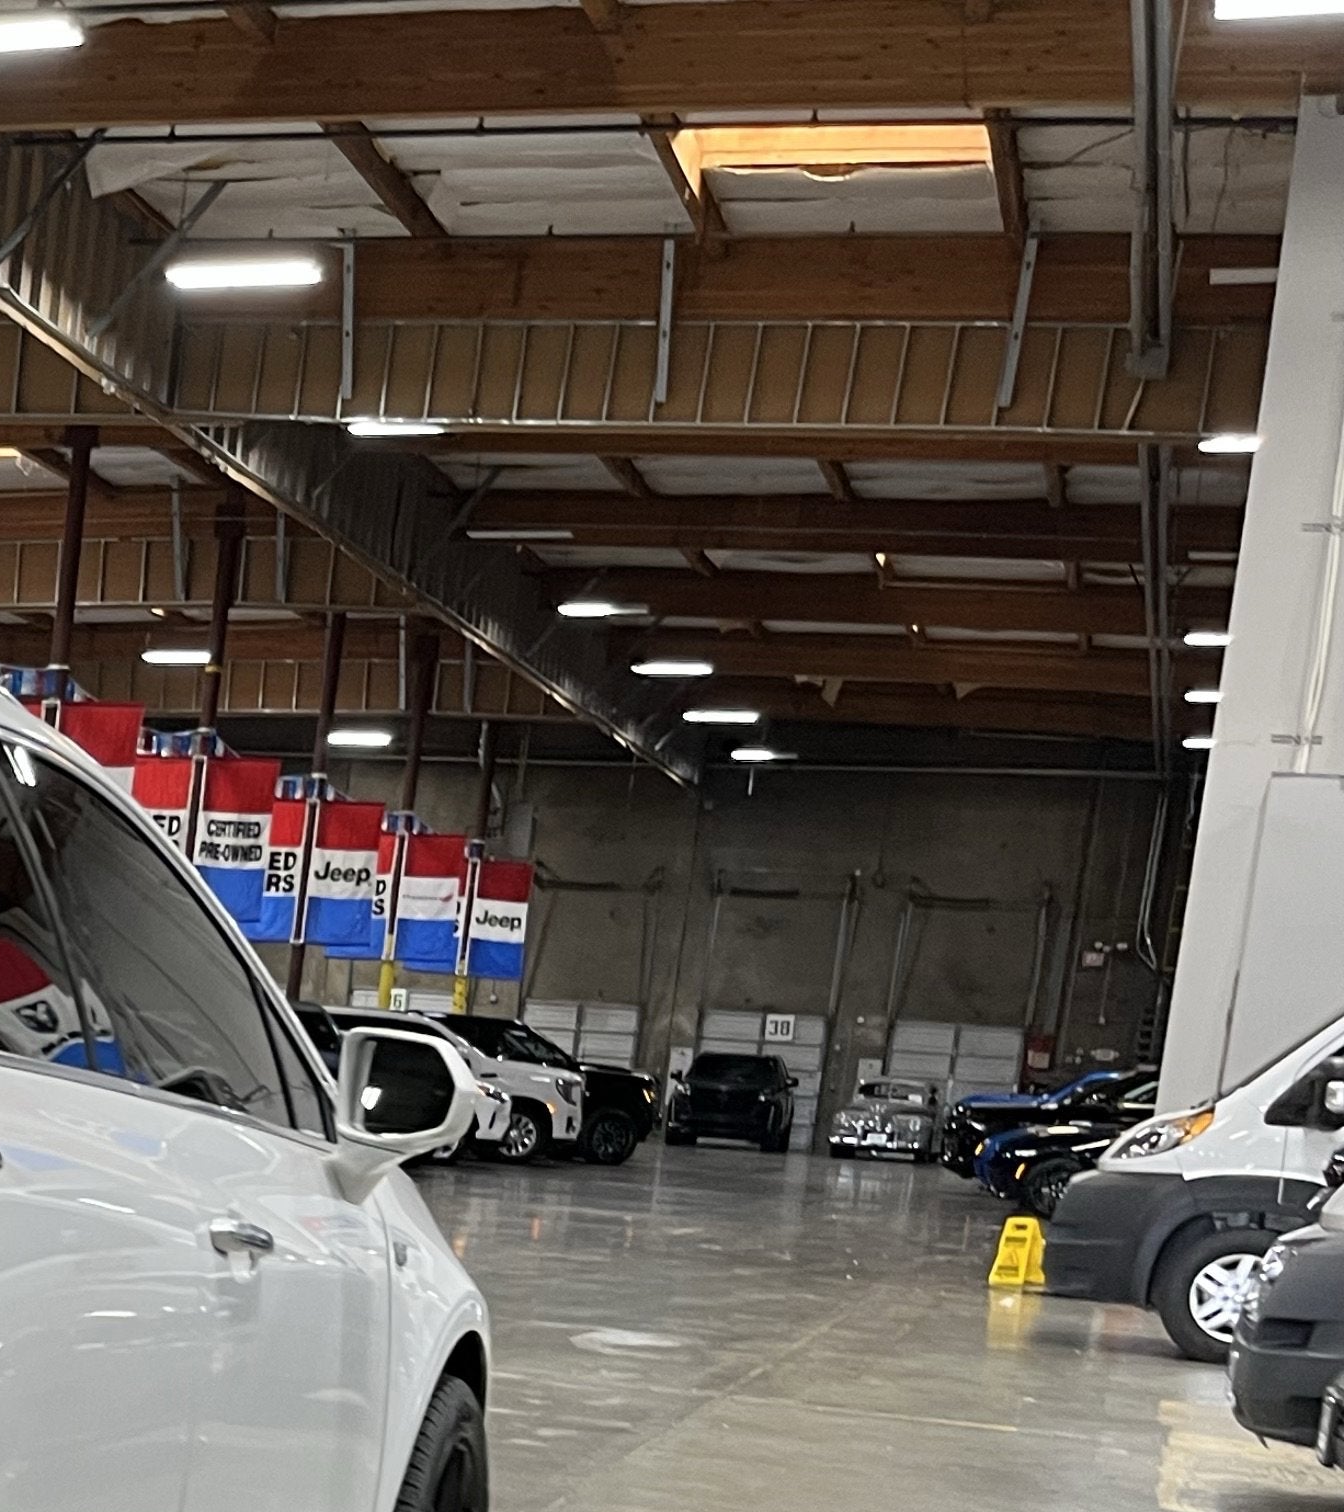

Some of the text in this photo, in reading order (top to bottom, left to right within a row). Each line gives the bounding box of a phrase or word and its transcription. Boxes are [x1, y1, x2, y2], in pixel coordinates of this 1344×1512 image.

[207, 819, 261, 839] CERTIFIED
[199, 841, 263, 862] PRE-OWNED
[314, 861, 372, 887] Jeep
[475, 909, 522, 932] Jeep
